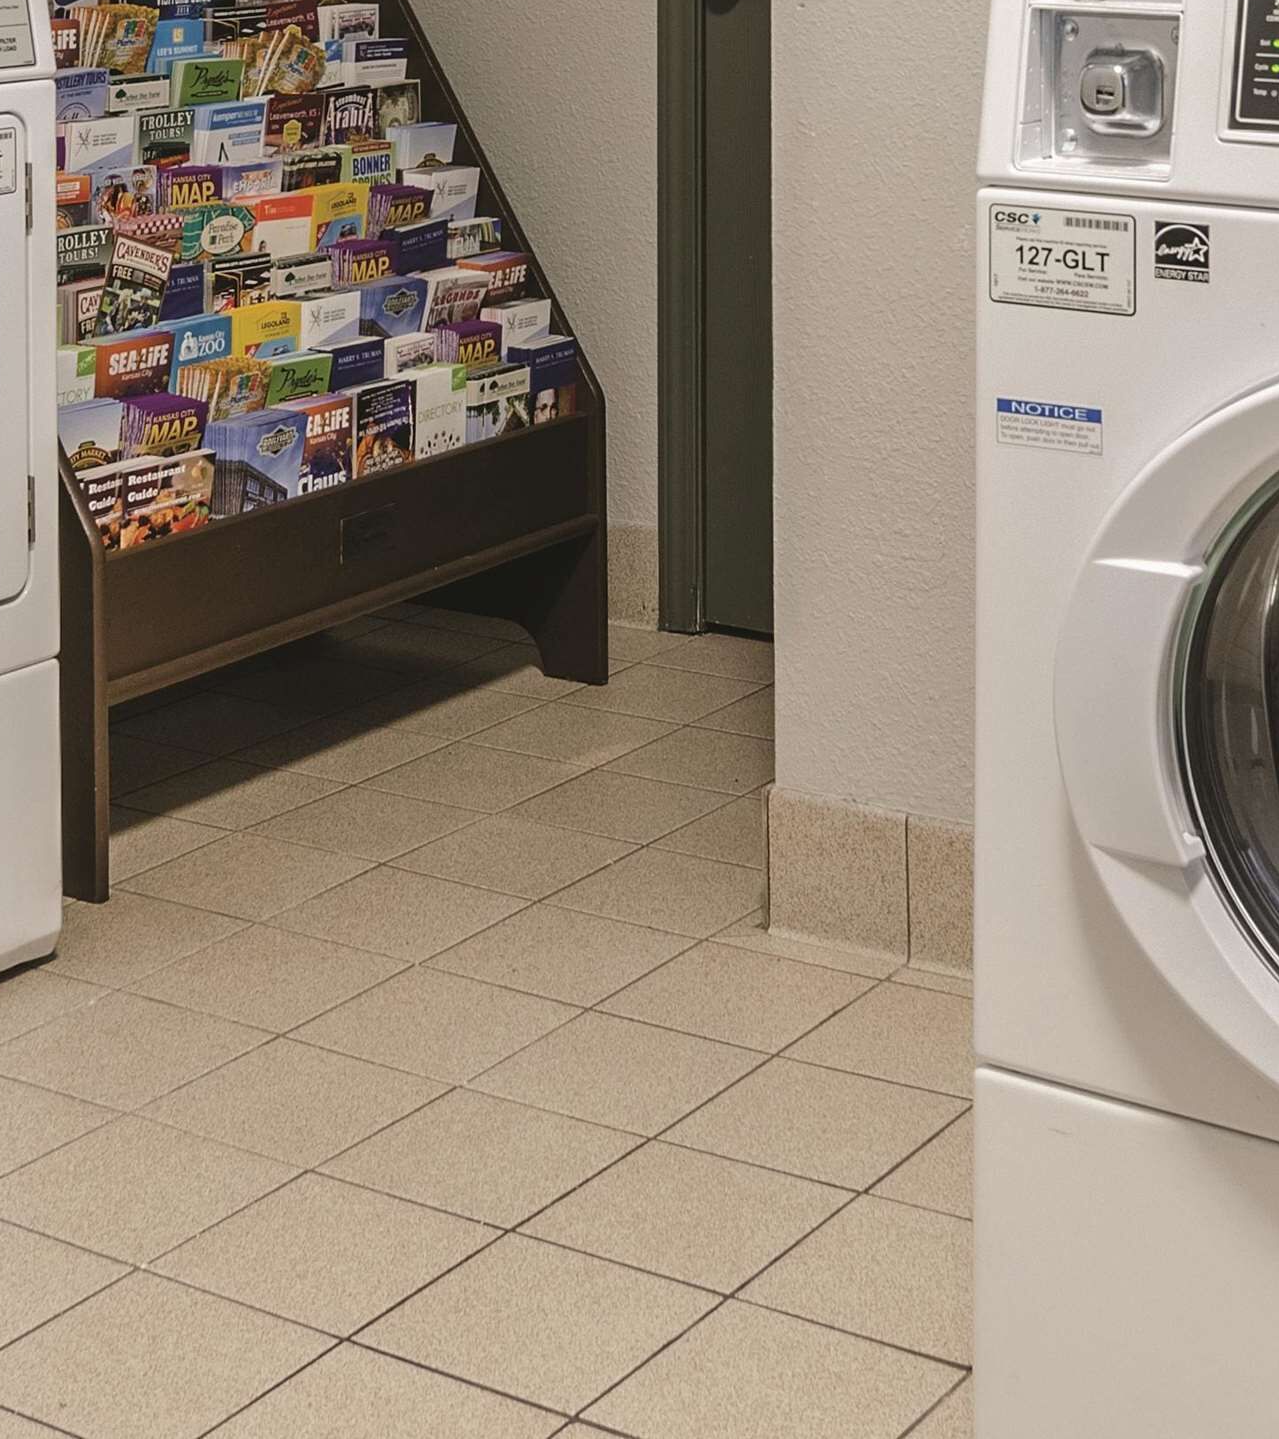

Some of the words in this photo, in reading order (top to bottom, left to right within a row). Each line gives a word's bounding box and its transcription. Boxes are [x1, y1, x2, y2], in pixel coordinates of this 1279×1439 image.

[141, 111, 193, 130] TROLLEY
[150, 127, 184, 141] TOURS!
[353, 153, 390, 175] BONNER
[172, 175, 197, 184] KANSAS
[198, 173, 210, 182] CITY
[172, 182, 214, 205] MAP
[386, 201, 424, 225] MAP
[994, 211, 1029, 224] CSC
[57, 230, 108, 251] ROLLEY
[58, 248, 98, 263] TOURS!
[116, 239, 169, 274] CAVENDER'S
[1016, 245, 1109, 272] 127-GLT
[112, 265, 132, 280] FREE
[352, 256, 390, 282] MAP
[1155, 268, 1187, 281] ENERGY
[1188, 271, 1209, 283] STAR
[198, 339, 225, 357] ZOO
[459, 336, 479, 345] KANSAS
[480, 332, 492, 341] CITY
[459, 339, 495, 364] MAP
[108, 350, 137, 376] SEA
[153, 412, 179, 422] KANSAS
[180, 409, 196, 419] CITY
[418, 400, 463, 423] DIRECTORY
[1011, 402, 1088, 421] NOTICE
[149, 418, 198, 446] MAP
[80, 451, 106, 461] MARKET
[128, 465, 186, 487] Restaurant
[127, 488, 158, 503] Guide
